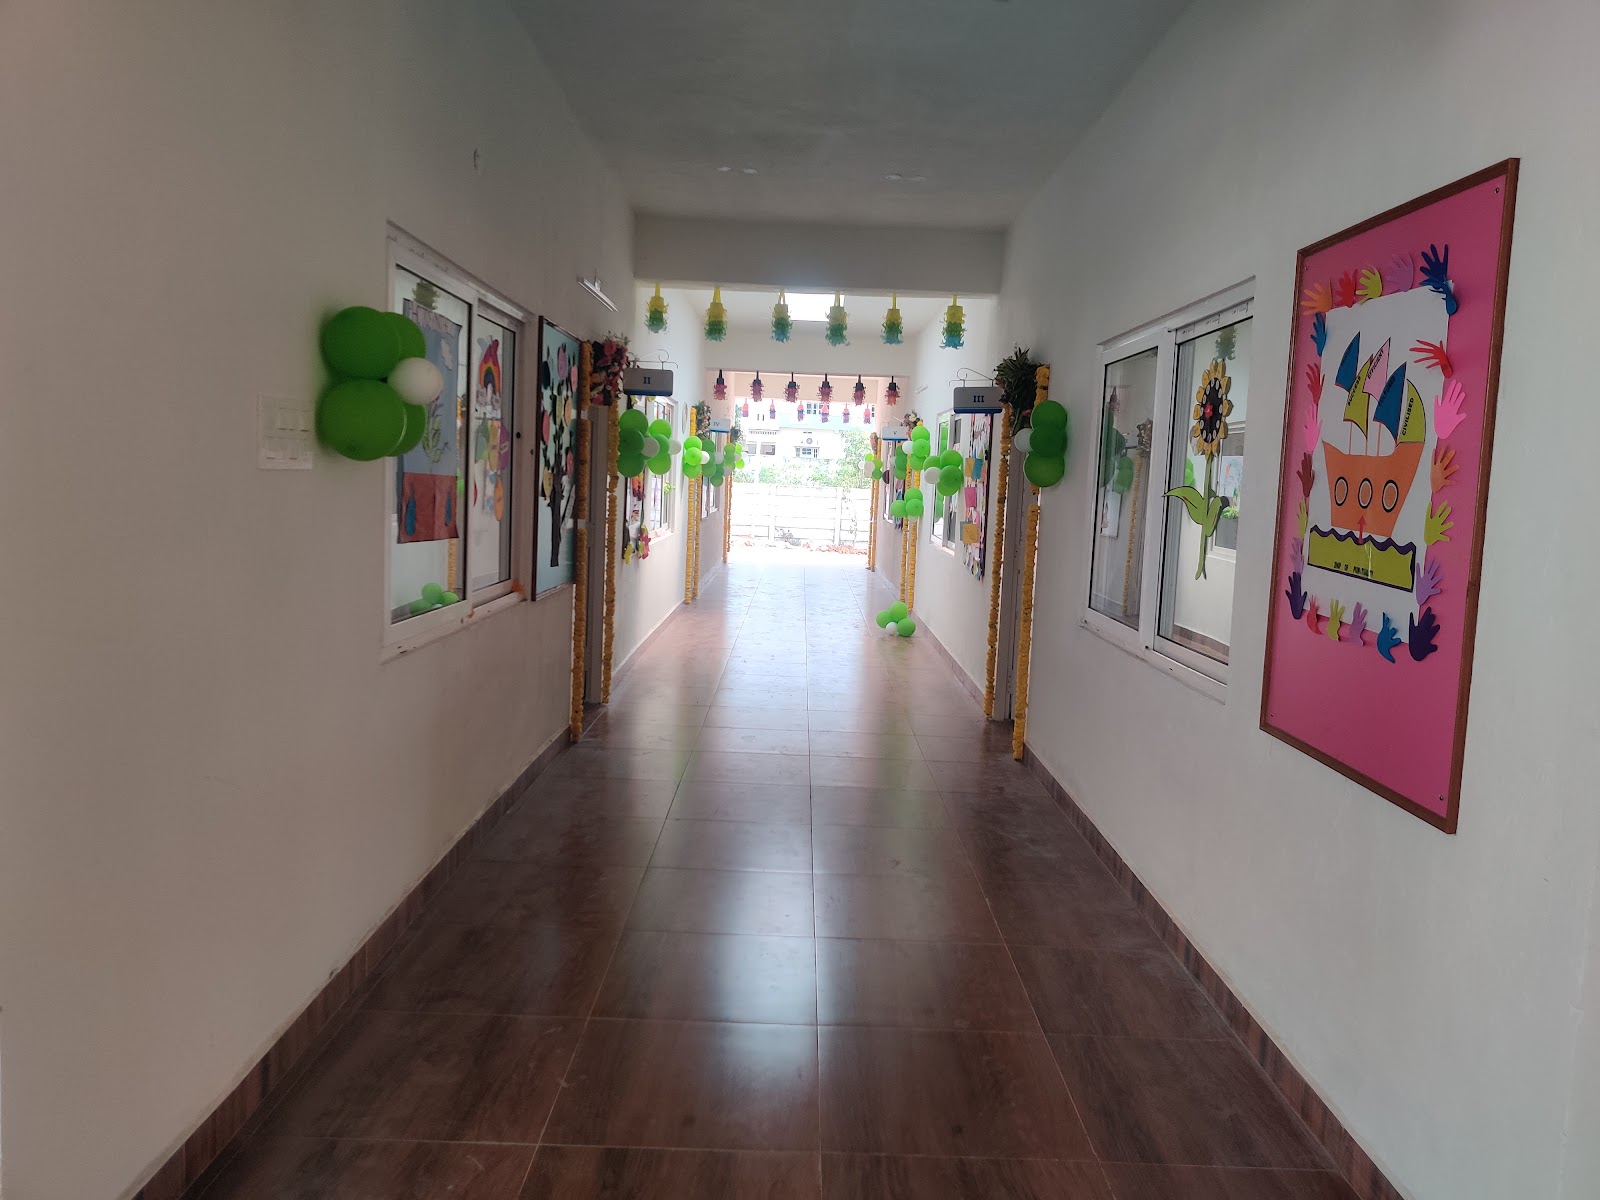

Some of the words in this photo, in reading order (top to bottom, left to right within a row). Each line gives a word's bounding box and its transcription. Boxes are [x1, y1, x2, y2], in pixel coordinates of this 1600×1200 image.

[1367, 348, 1385, 379] EFFICIENT
[643, 376, 651, 384] II
[1347, 375, 1361, 406] SUCCESS
[1401, 397, 1414, 436] CIVILISED
